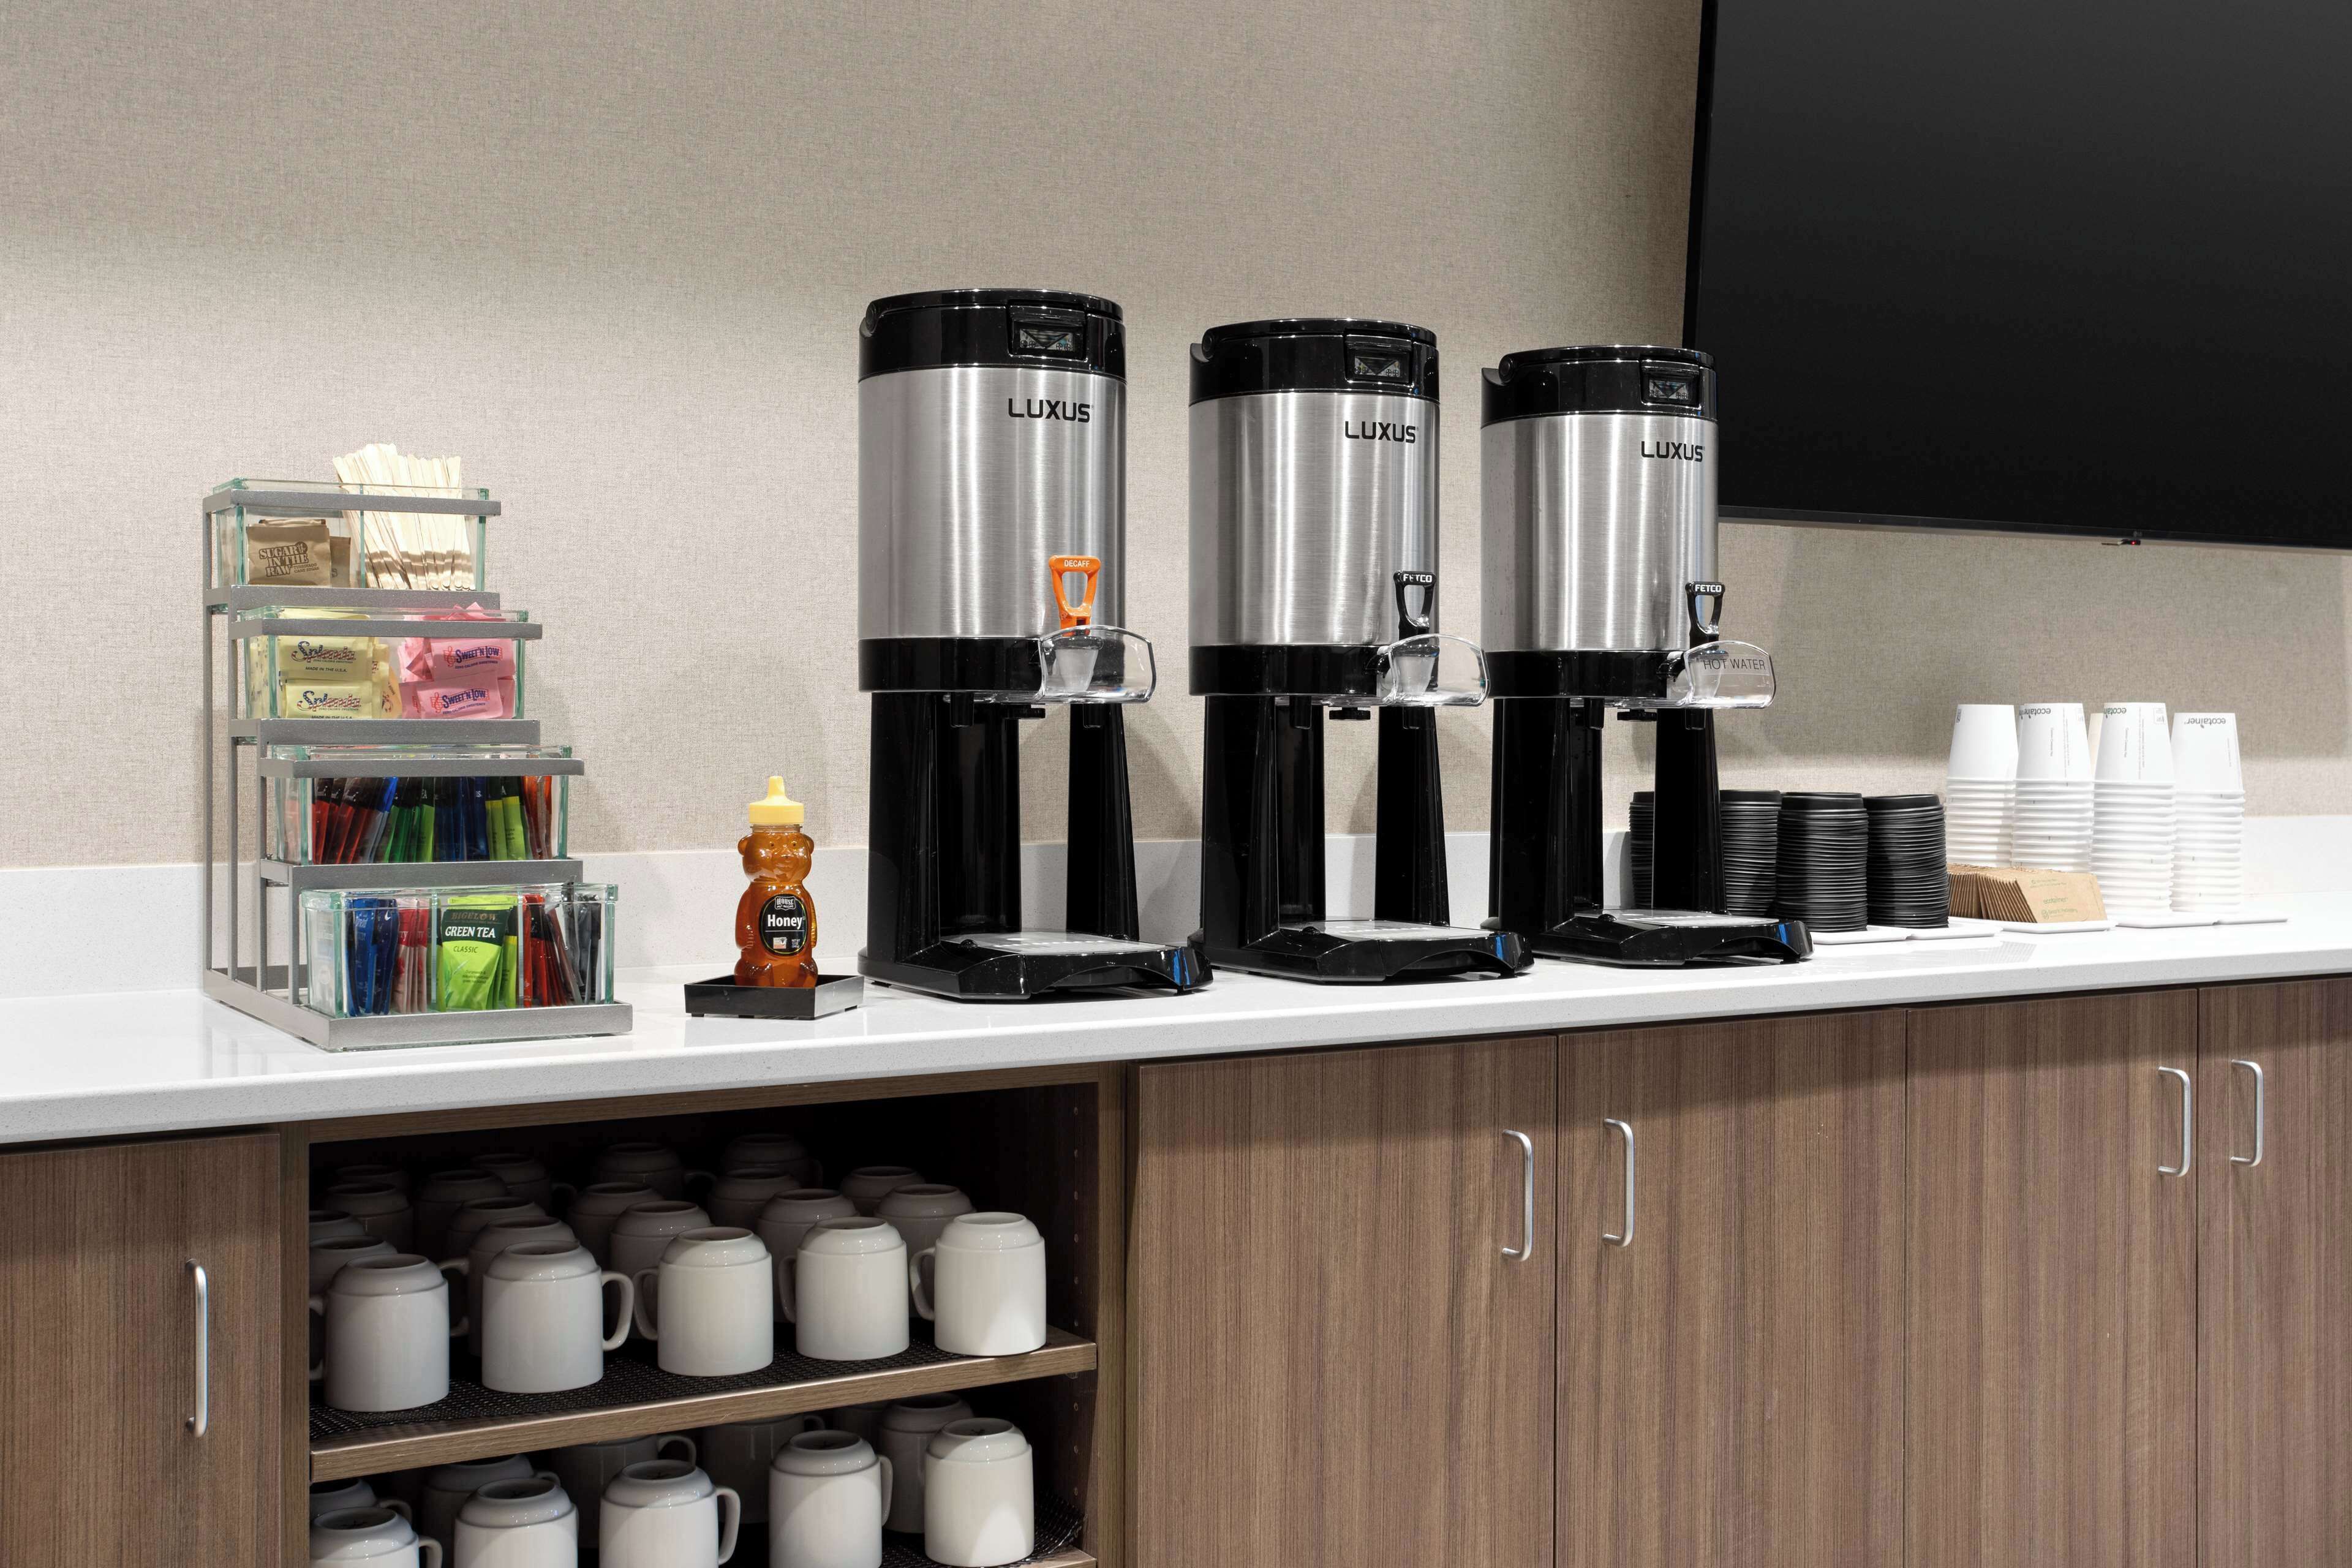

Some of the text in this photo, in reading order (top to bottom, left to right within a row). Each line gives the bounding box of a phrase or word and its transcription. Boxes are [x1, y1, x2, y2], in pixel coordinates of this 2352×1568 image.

[1008, 398, 1090, 423] LUXUS
[1345, 421, 1416, 444] LUXUS
[1641, 440, 1703, 463] LUXUS
[260, 545, 298, 559] SUGAR
[268, 554, 309, 567] IN THE
[266, 566, 292, 577] RAW
[1403, 574, 1433, 583] FETCO
[1695, 584, 1722, 593] FETCO
[291, 641, 356, 663] Splenda
[1703, 658, 1766, 670] HOT WATER
[297, 690, 361, 712] Splenda
[767, 914, 803, 930] Honey
[445, 926, 496, 938] GREEN TEA
